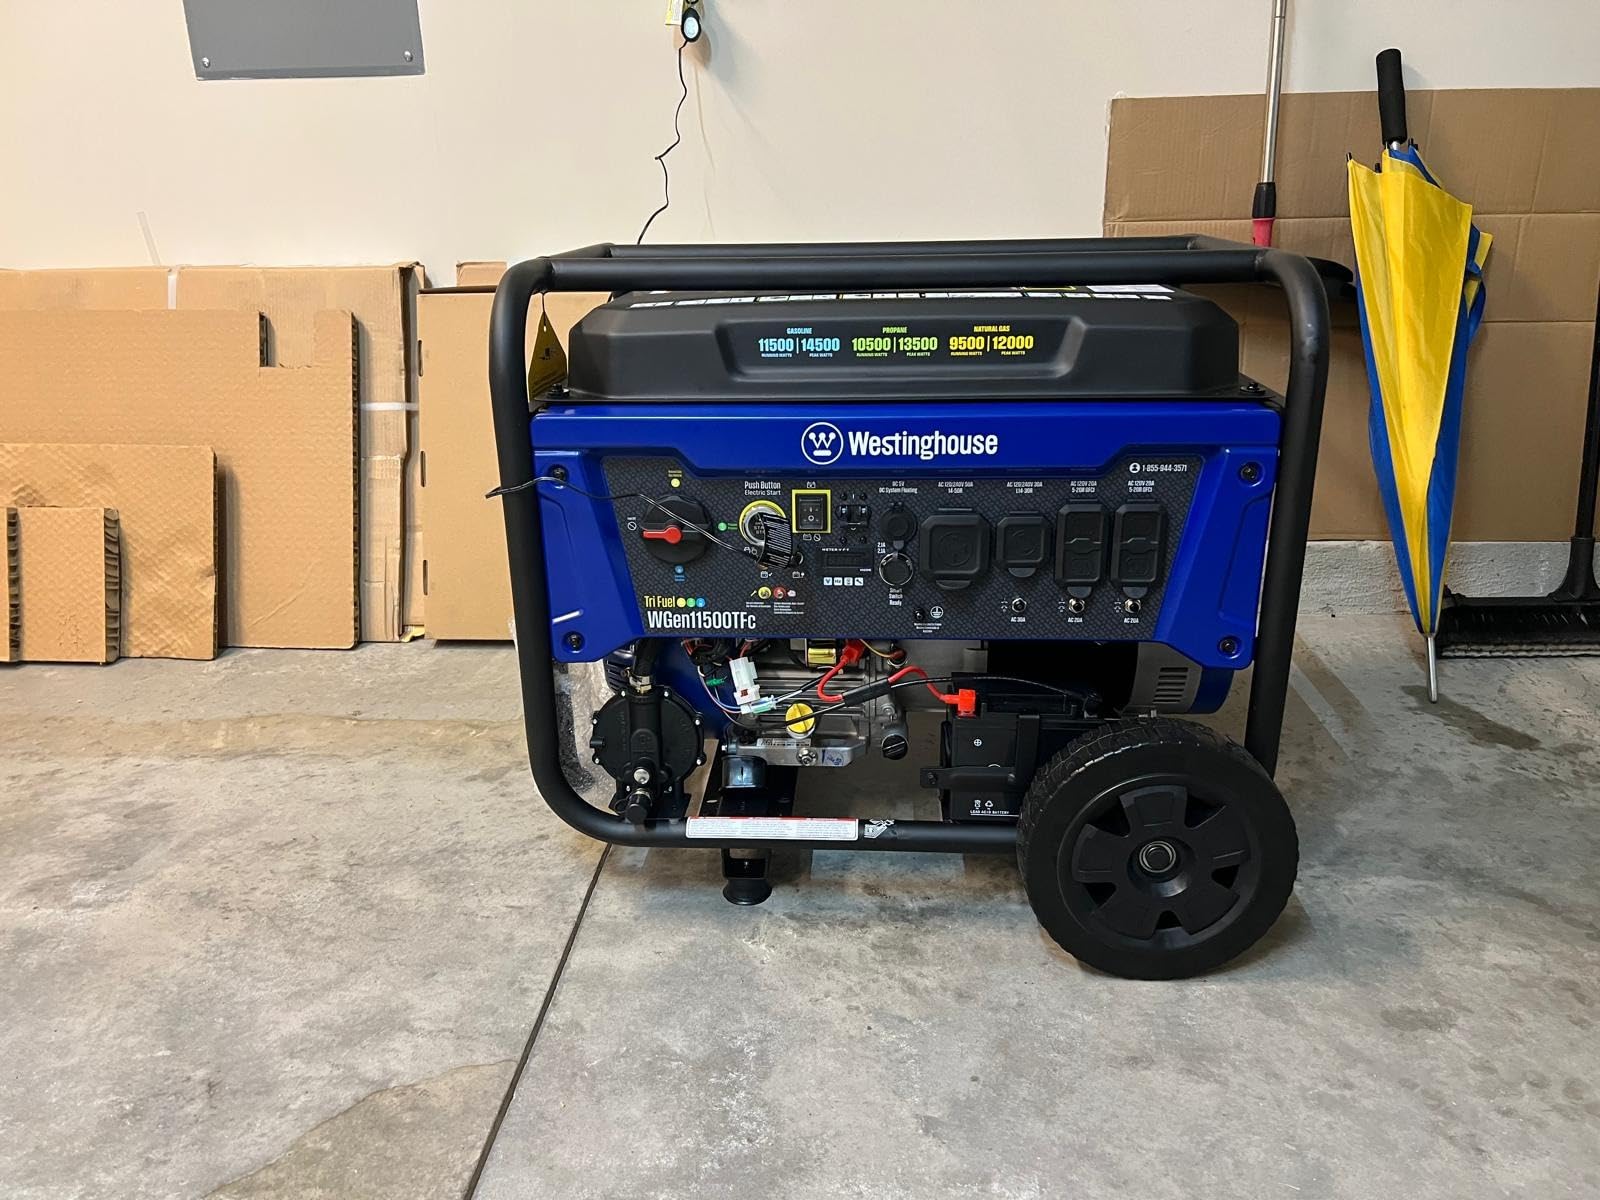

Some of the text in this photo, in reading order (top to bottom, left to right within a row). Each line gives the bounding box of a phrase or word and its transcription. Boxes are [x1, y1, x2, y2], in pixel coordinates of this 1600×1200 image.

[758, 338, 840, 352] 11500 14500
[852, 337, 938, 351] 10500 13500
[949, 335, 1034, 350] 9500 12000
[848, 431, 998, 460] Westinghouse
[1142, 464, 1187, 472] 1-855-944-3571
[744, 481, 780, 489] Push Button
[644, 595, 676, 608] Tri Fuel
[647, 611, 756, 629] WGen11500TFc
